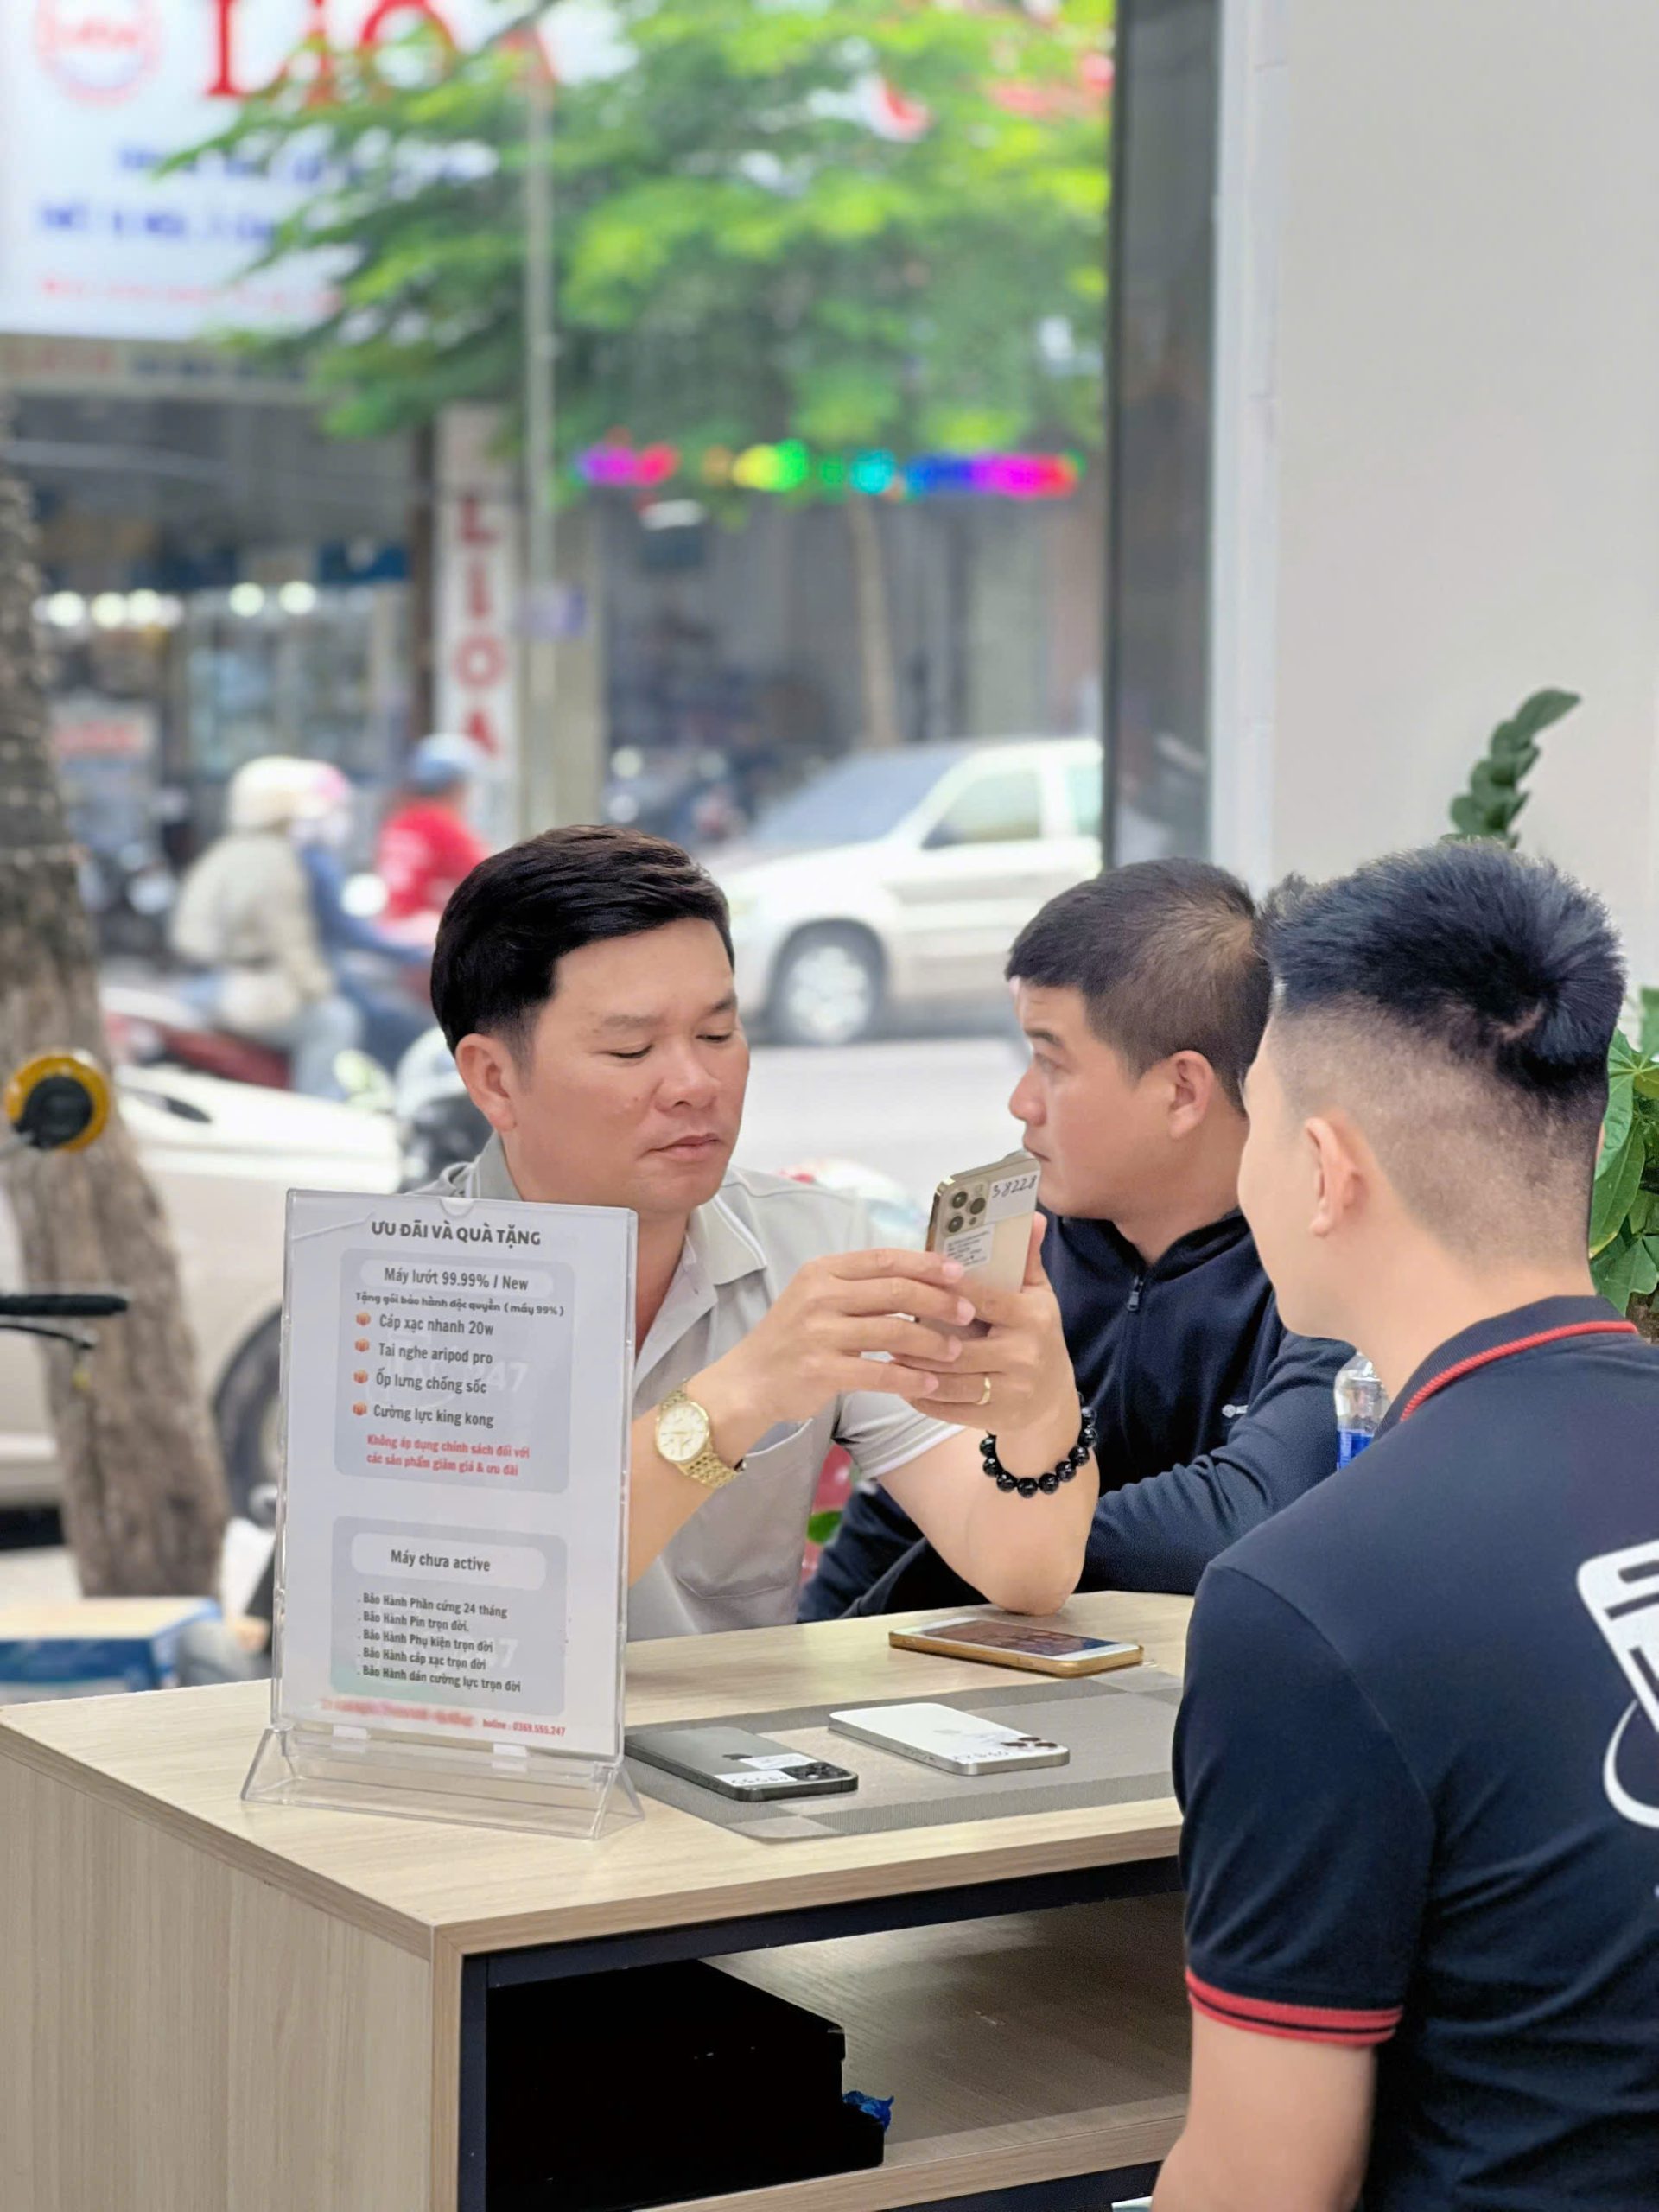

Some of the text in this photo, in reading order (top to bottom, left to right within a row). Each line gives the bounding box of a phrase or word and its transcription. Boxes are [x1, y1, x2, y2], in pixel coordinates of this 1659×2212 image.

[372, 1219, 541, 1249] ƯU ĐÃI VÀ QUÀ TẶNG
[385, 1267, 409, 1285] Máy
[412, 1269, 438, 1284] lướt
[442, 1272, 489, 1288] 99.99%
[502, 1276, 528, 1291] New
[379, 1313, 493, 1335] Cáp xạc nhanh 20w
[378, 1343, 493, 1365] Tai nghe aripod pro
[376, 1367, 487, 1394] Ốp lưng chống sốc
[373, 1404, 494, 1428] Cường lực king kong
[391, 1549, 491, 1572] Máy chưa active
[383, 1594, 407, 1607] Hành
[436, 1600, 461, 1615] cứng
[464, 1603, 475, 1614] 24
[479, 1605, 508, 1619] tháng
[383, 1612, 407, 1625] Hành
[410, 1616, 425, 1627] Pin
[428, 1618, 448, 1631] trọn
[383, 1630, 407, 1643] Hành
[410, 1634, 428, 1649] Phụ
[454, 1639, 474, 1653] trọn
[383, 1649, 407, 1662] Hành
[410, 1652, 426, 1666] cáp
[448, 1656, 467, 1670] trọn
[481, 1679, 502, 1692] trọn
